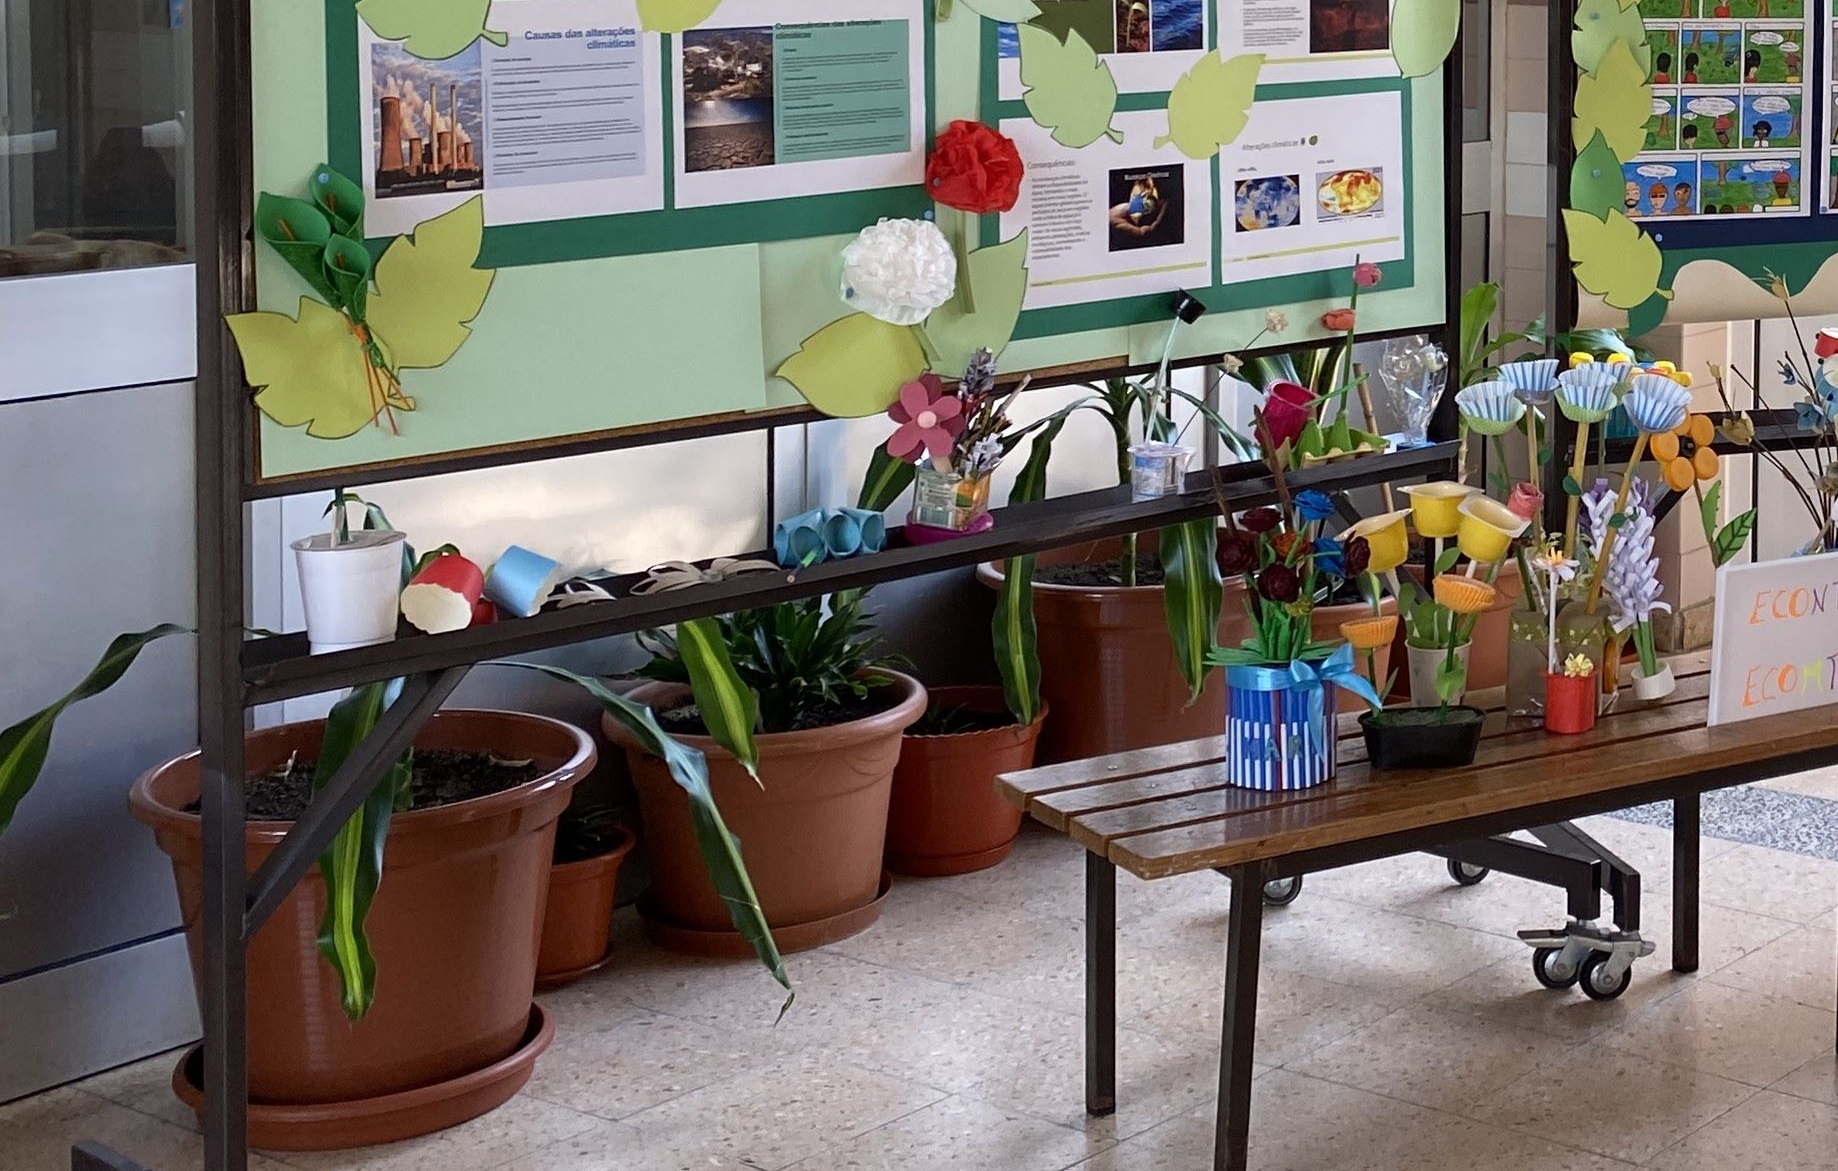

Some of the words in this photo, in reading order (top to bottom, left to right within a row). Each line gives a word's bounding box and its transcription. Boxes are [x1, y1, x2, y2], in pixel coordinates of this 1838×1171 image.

[524, 30, 562, 41] Causas
[565, 29, 583, 39] das
[585, 26, 636, 38] alterações
[587, 39, 636, 49] climáticas
